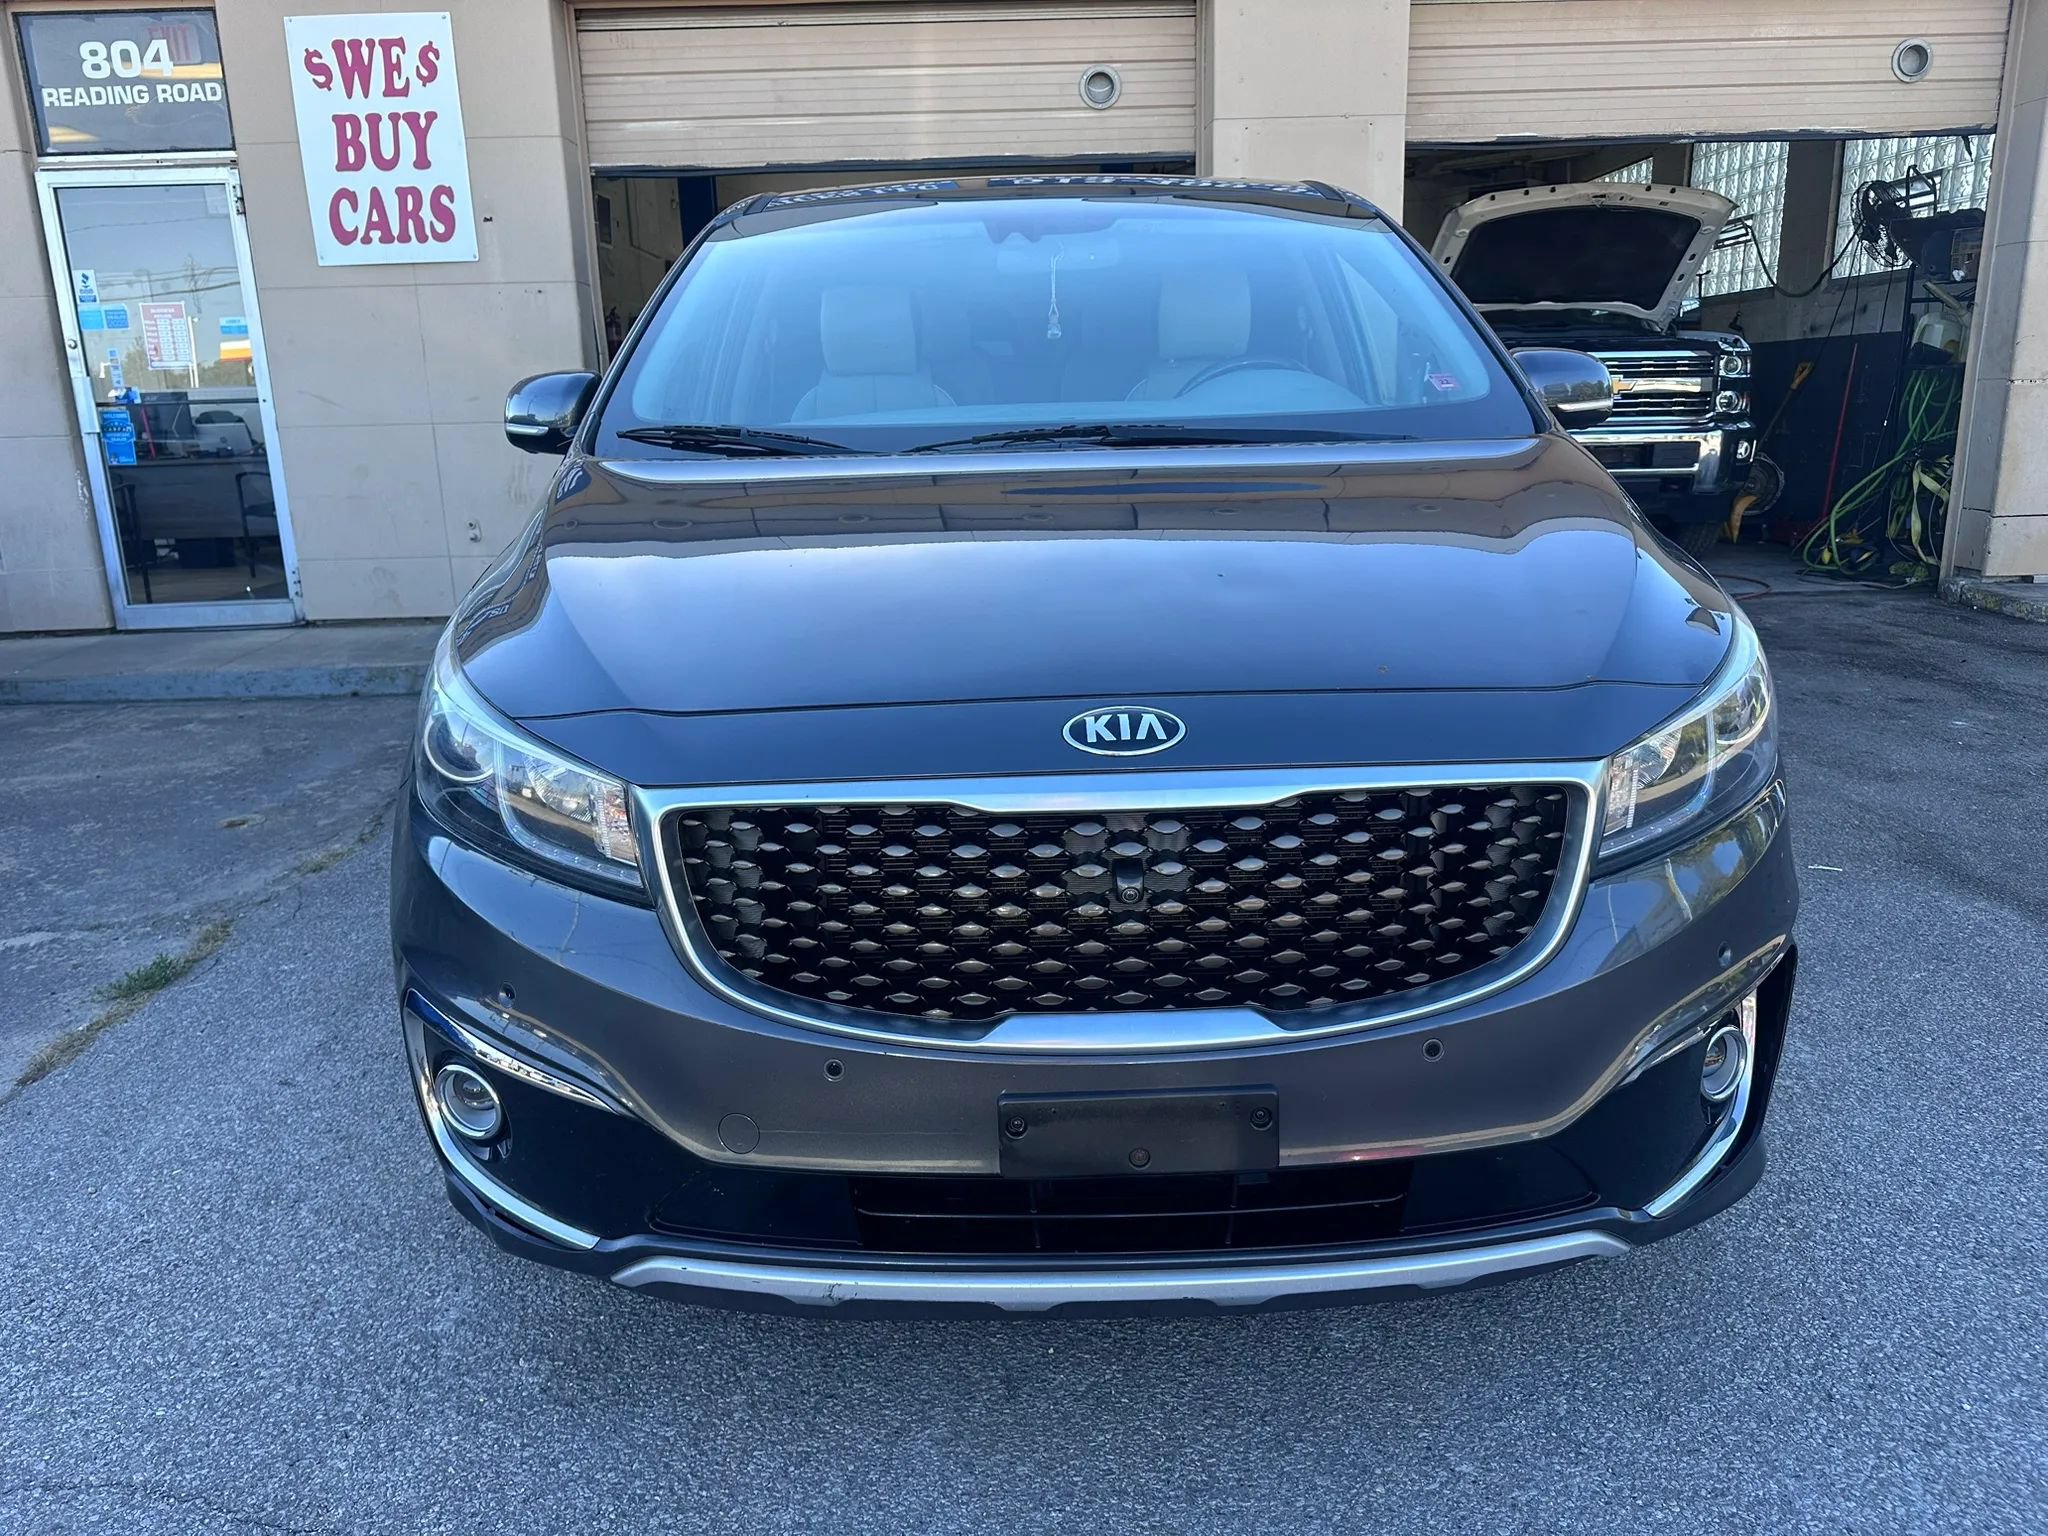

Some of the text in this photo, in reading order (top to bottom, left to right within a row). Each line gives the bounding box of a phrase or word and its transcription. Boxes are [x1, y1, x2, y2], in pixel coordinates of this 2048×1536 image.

[80, 39, 174, 78] 804
[41, 82, 222, 107] READING ROAD
[331, 111, 438, 172] BUY
[329, 184, 456, 246] CARS
[1083, 713, 1168, 742] KIA
